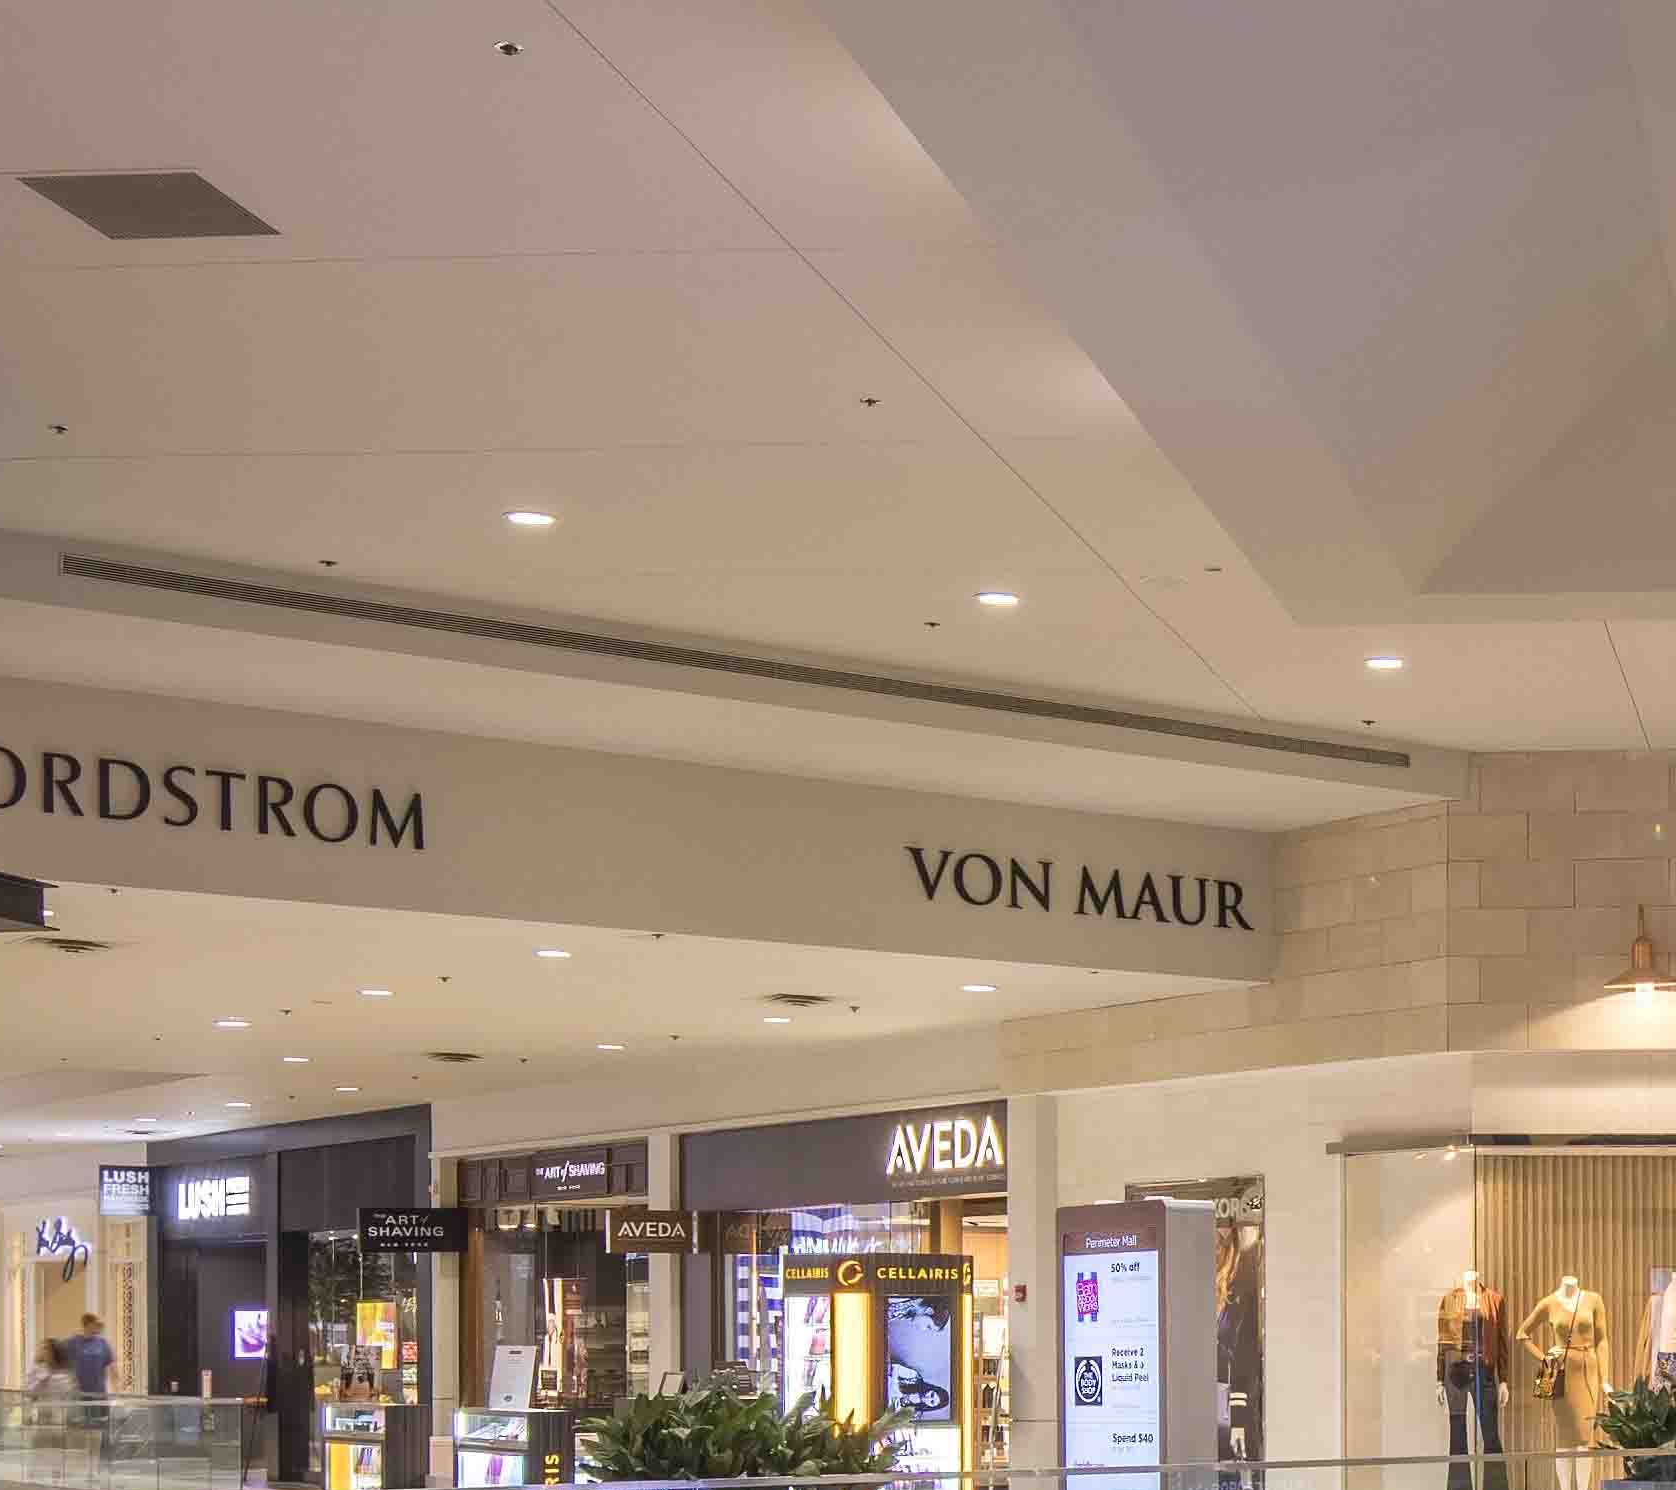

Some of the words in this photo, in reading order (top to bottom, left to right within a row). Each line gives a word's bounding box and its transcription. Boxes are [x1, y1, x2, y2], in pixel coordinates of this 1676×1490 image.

[904, 845, 1053, 912] VON
[1074, 864, 1255, 931] MAUR
[886, 1115, 1004, 1174] AVEDA
[569, 1162, 605, 1177] SHAVING
[103, 1170, 149, 1183] LUSH
[103, 1184, 149, 1195] FRESH
[178, 1178, 225, 1220] LUSH
[385, 1215, 416, 1225] ART
[367, 1226, 445, 1238] SHAVING
[617, 1222, 686, 1238] AVEDA
[1085, 1236, 1121, 1248] Perimeter
[1122, 1235, 1137, 1247] Mall
[785, 1267, 829, 1279] CELLAIRIS
[876, 1267, 959, 1280] CELLAIRIS
[1110, 1262, 1127, 1273] 50%
[1128, 1261, 1140, 1272] off
[1111, 1347, 1138, 1357] Receive
[1111, 1361, 1132, 1369] Masks
[1111, 1374, 1133, 1384] Liquid
[1134, 1373, 1149, 1382] Peel
[1112, 1432, 1137, 1446] Spend
[1137, 1432, 1154, 1444] $40
